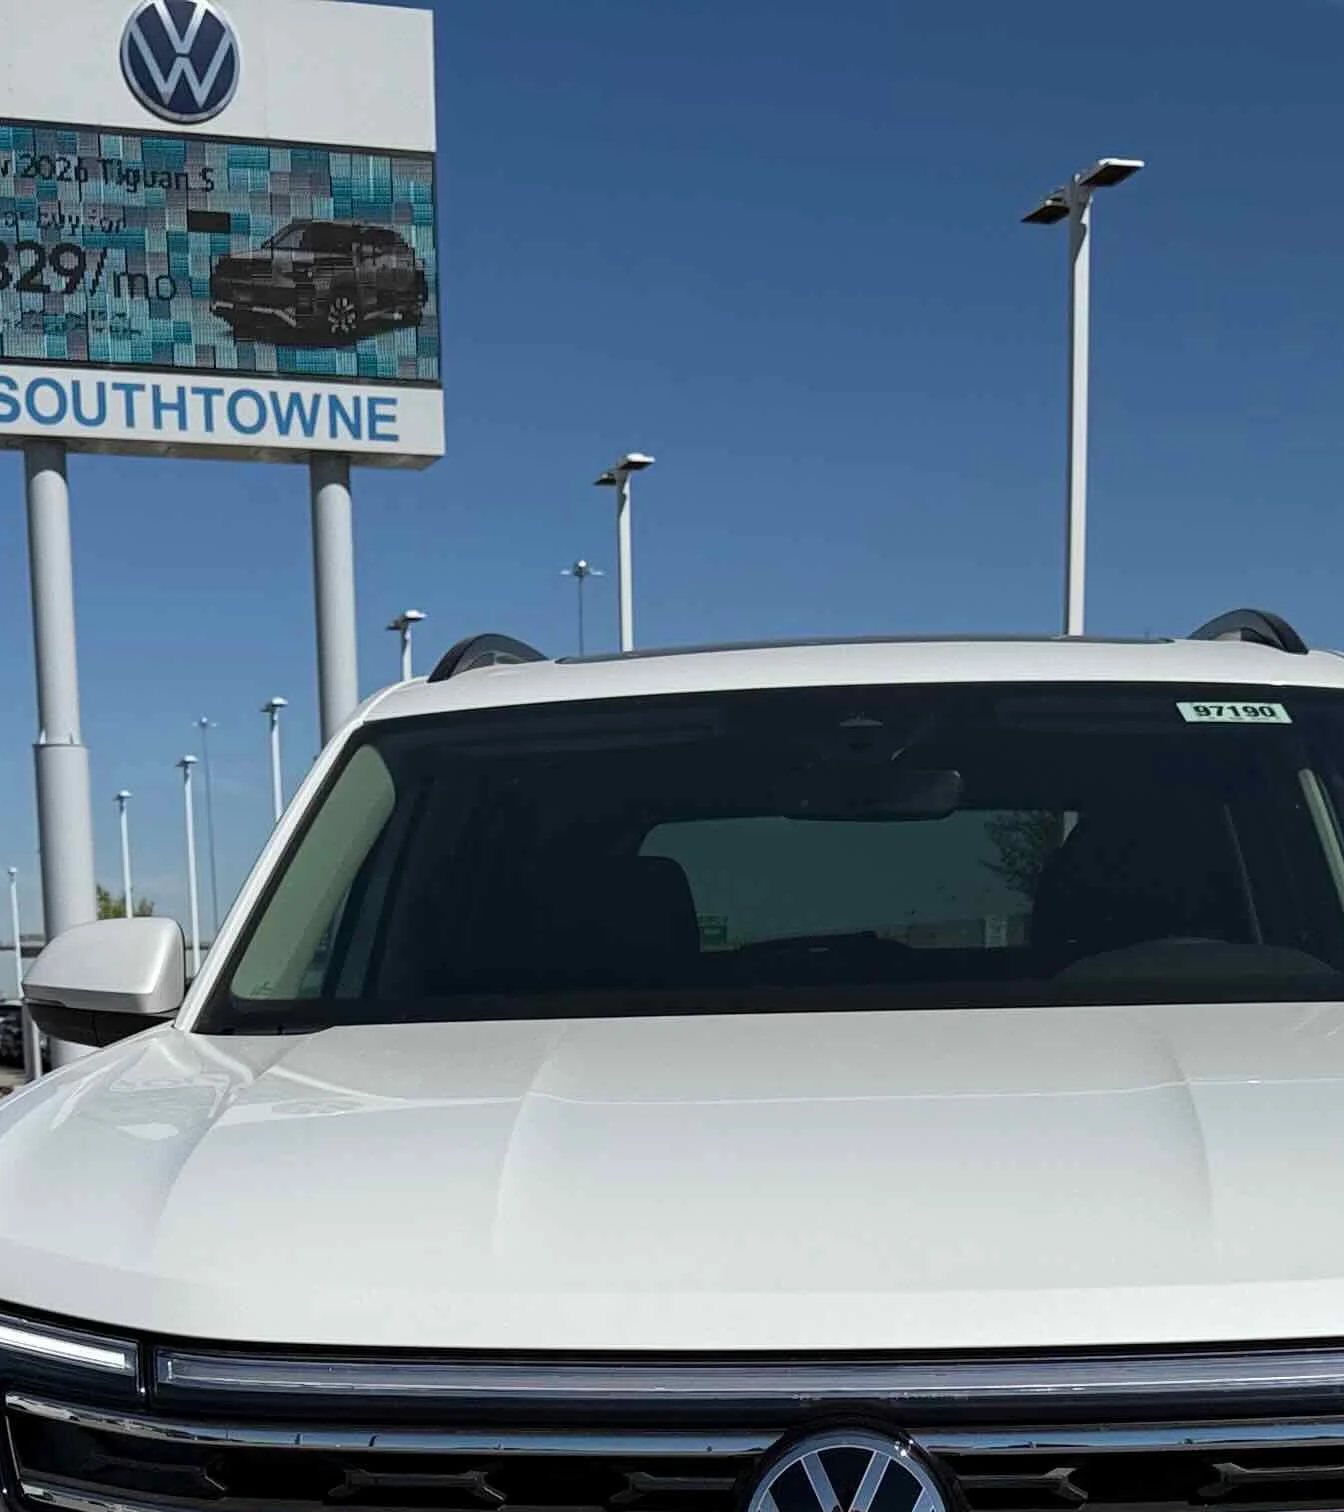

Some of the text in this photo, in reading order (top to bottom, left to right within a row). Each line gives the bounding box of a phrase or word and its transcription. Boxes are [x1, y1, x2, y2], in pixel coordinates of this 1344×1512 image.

[22, 153, 89, 183] 2026
[98, 158, 188, 193] Tiguan
[199, 168, 215, 192] S
[1193, 705, 1276, 718] 97190
